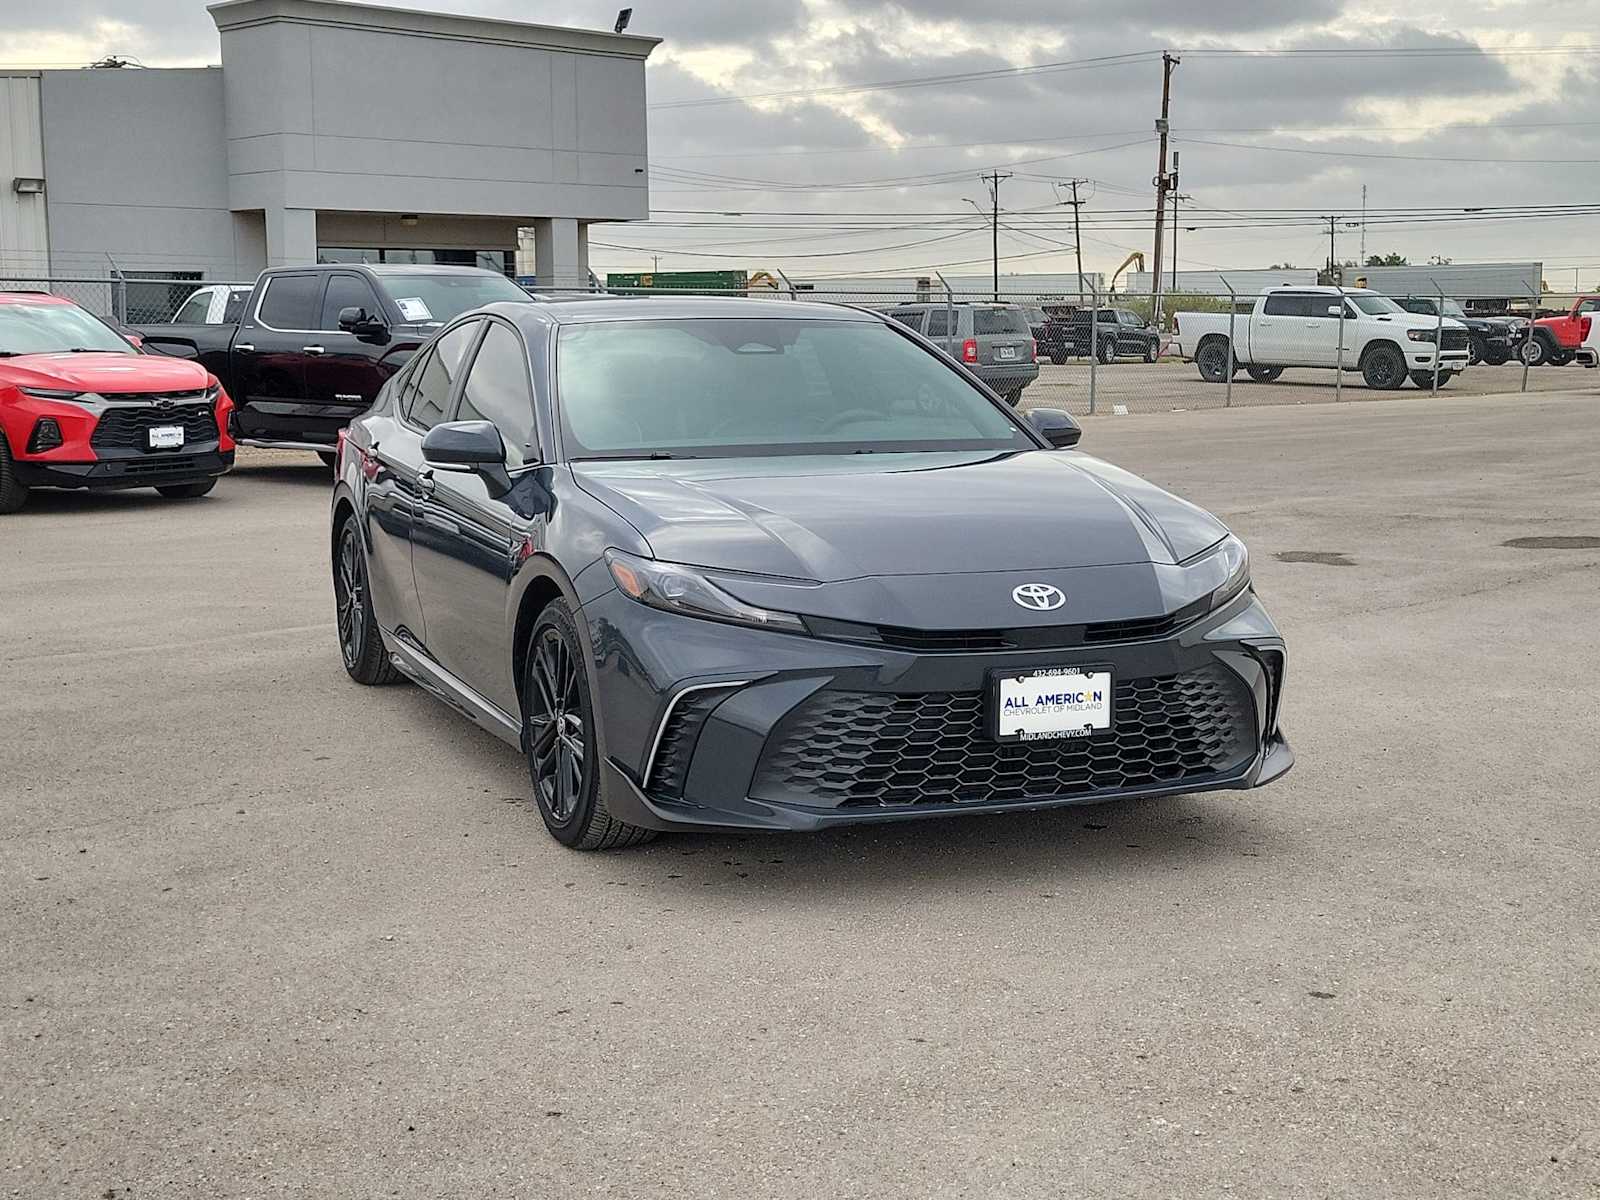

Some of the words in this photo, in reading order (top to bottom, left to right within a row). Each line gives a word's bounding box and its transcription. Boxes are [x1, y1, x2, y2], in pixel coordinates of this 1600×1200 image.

[1032, 667, 1080, 677] 432-694-9601
[1004, 696, 1029, 708] ALL
[1003, 706, 1051, 717] CHEVROLET
[1053, 705, 1065, 713] OF
[1066, 702, 1103, 712] MIDLAND
[1020, 729, 1092, 741] MIDLANDCHEVY.COM
